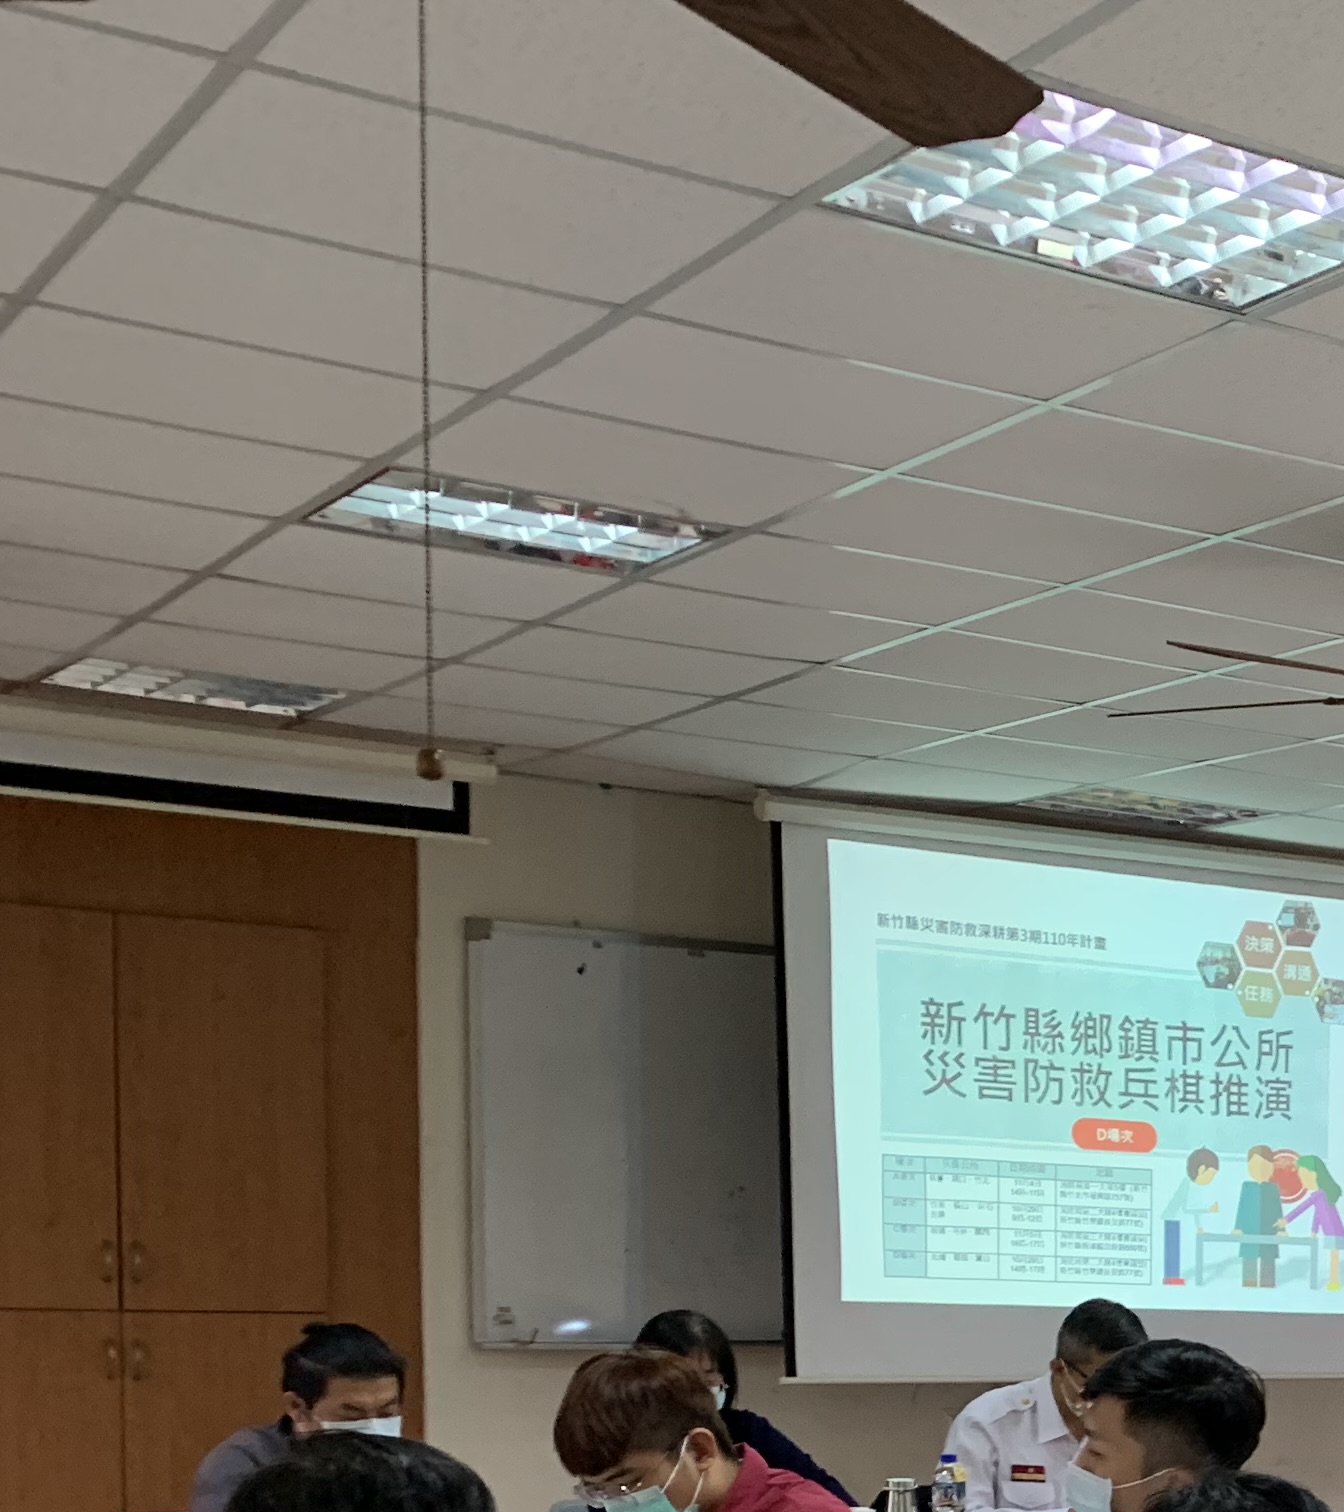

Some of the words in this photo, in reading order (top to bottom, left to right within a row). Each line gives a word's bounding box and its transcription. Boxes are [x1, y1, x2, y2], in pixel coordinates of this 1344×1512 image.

[1244, 935, 1275, 953] 決策
[920, 997, 1294, 1075] 新竹縣鄉鎮市公所
[922, 1049, 1293, 1121] 災害防救兵棋推演
